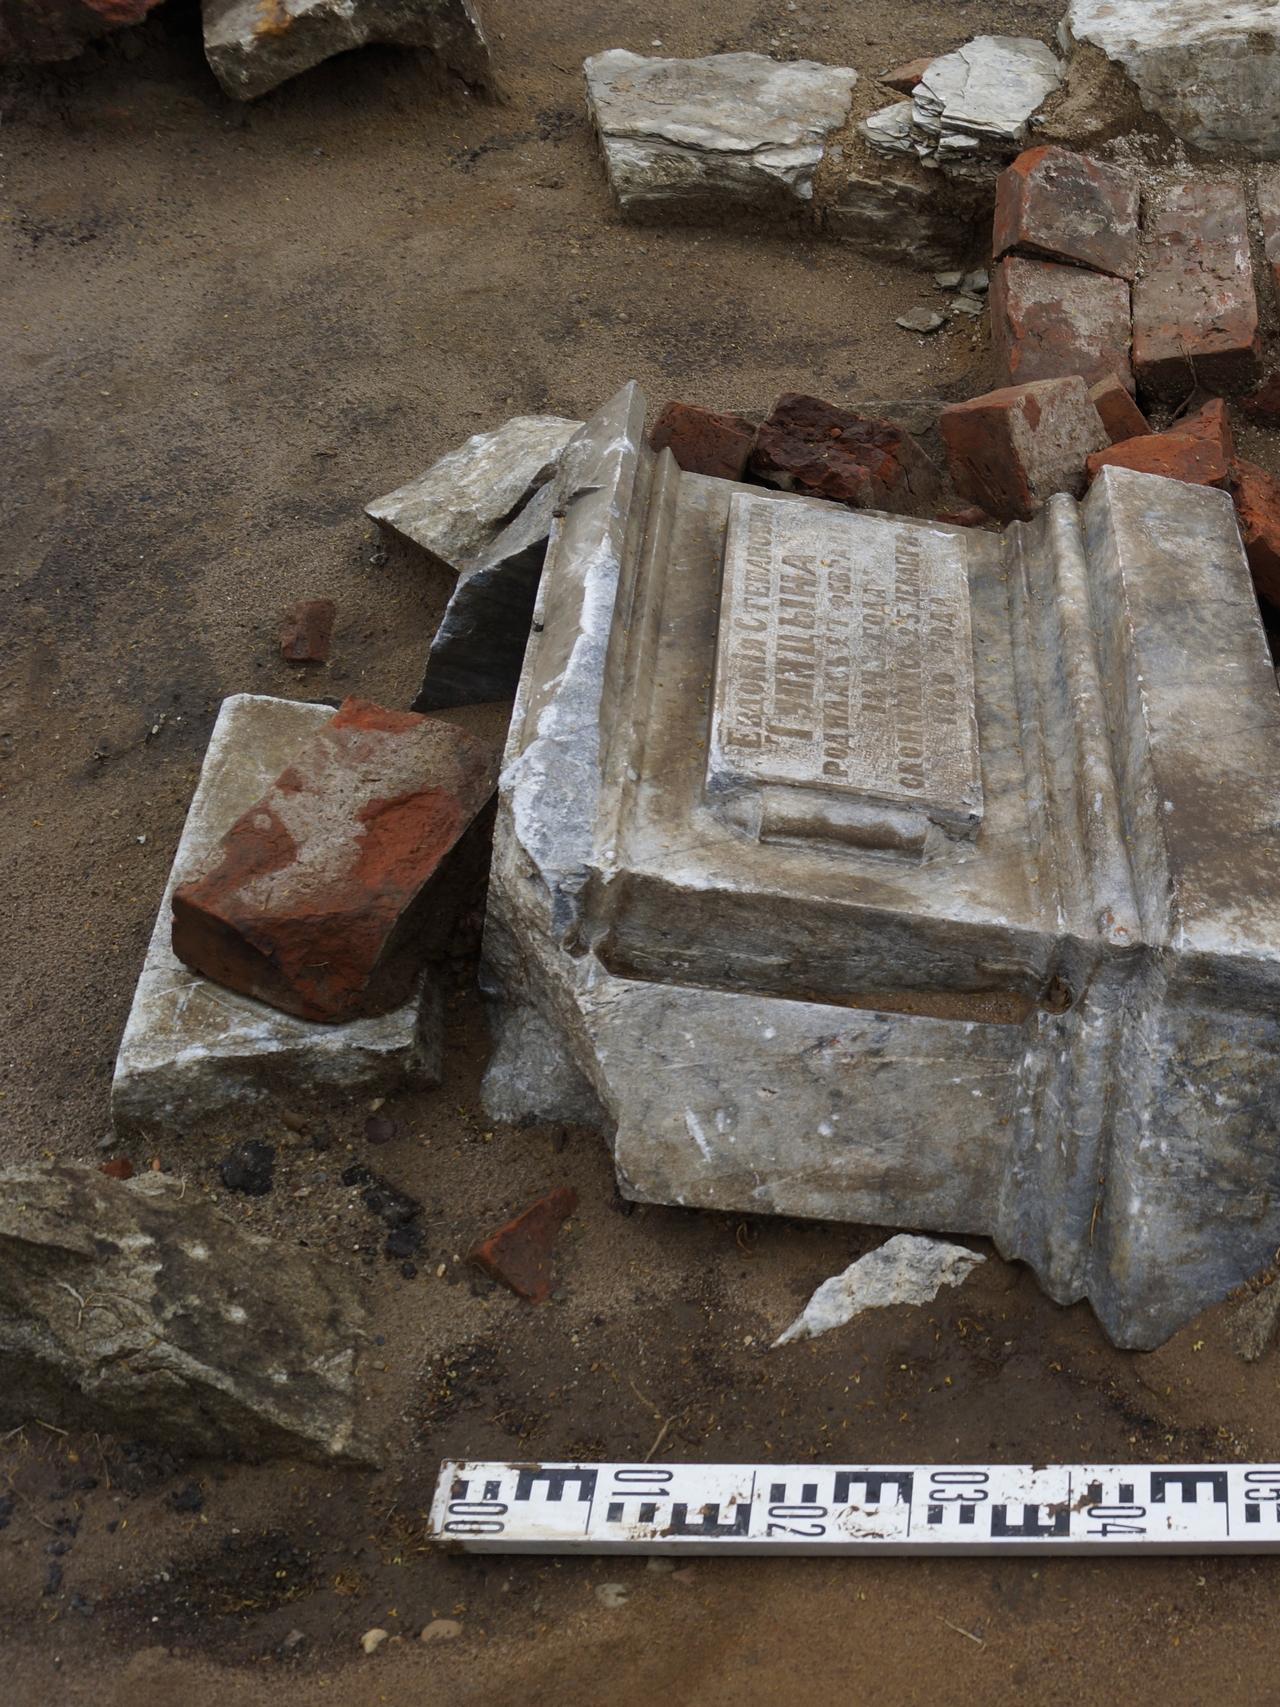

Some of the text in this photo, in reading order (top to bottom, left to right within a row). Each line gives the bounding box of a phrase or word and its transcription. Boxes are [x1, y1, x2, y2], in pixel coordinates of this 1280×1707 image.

[613, 1469, 674, 1498] 01
[929, 1472, 988, 1504] 03
[444, 1501, 509, 1534] 00
[767, 1505, 827, 1538] 02
[1086, 1505, 1147, 1536] 04
